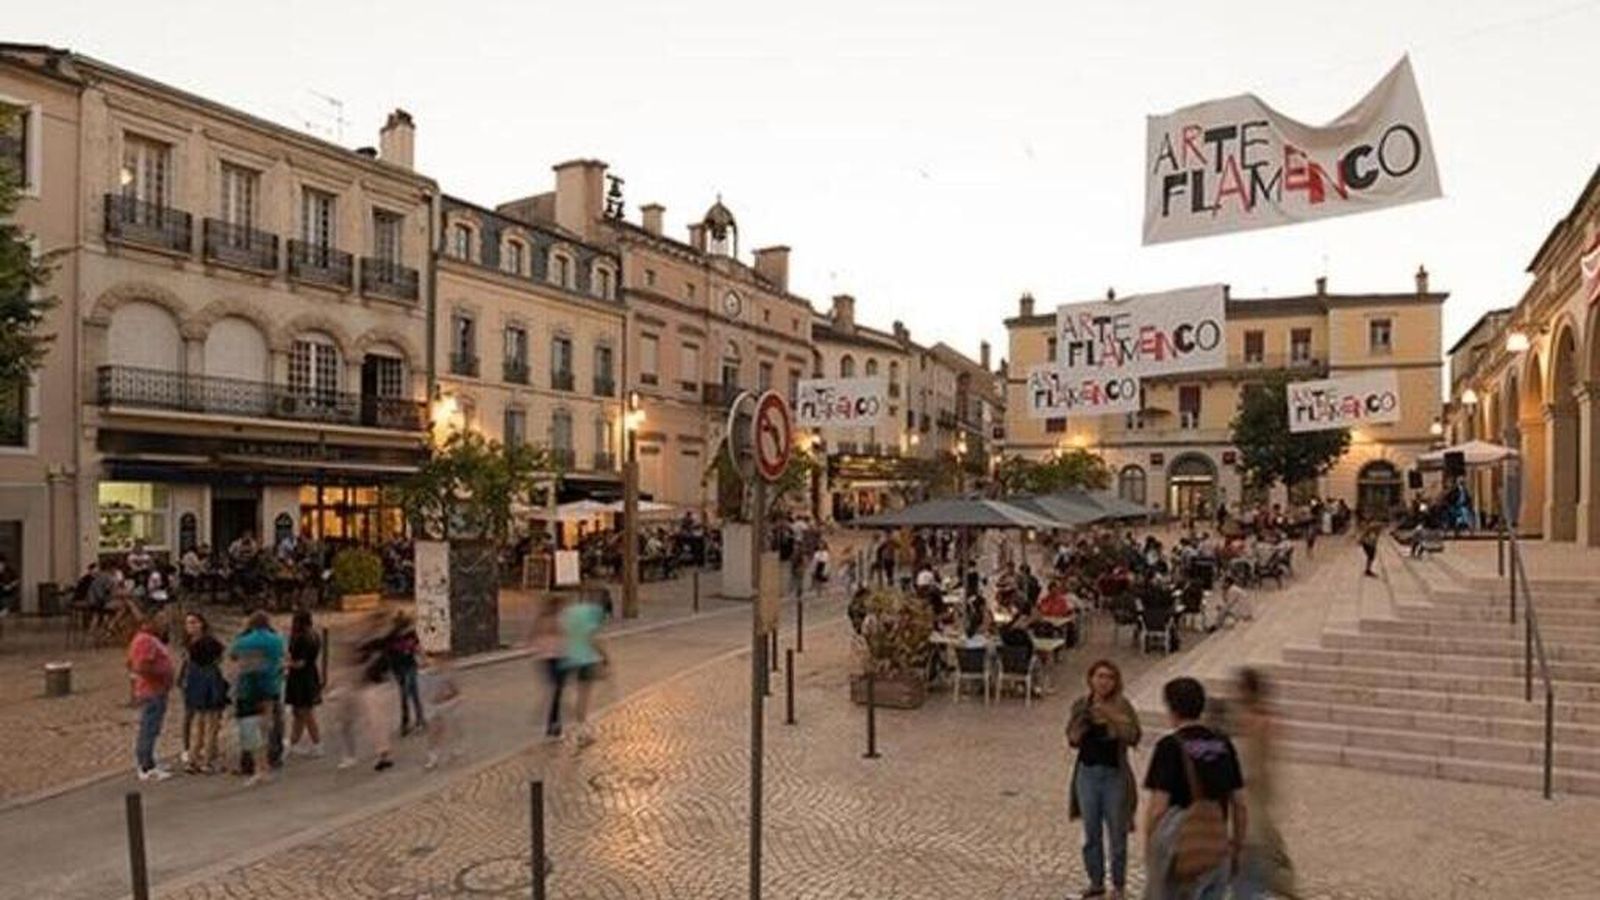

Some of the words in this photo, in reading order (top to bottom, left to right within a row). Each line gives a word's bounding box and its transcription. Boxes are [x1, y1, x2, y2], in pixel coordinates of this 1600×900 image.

[1153, 121, 1269, 174] ARTE
[1162, 124, 1422, 217] FLAMENCO
[1062, 311, 1131, 343] ARTE
[1068, 319, 1221, 367] FLAMENCO
